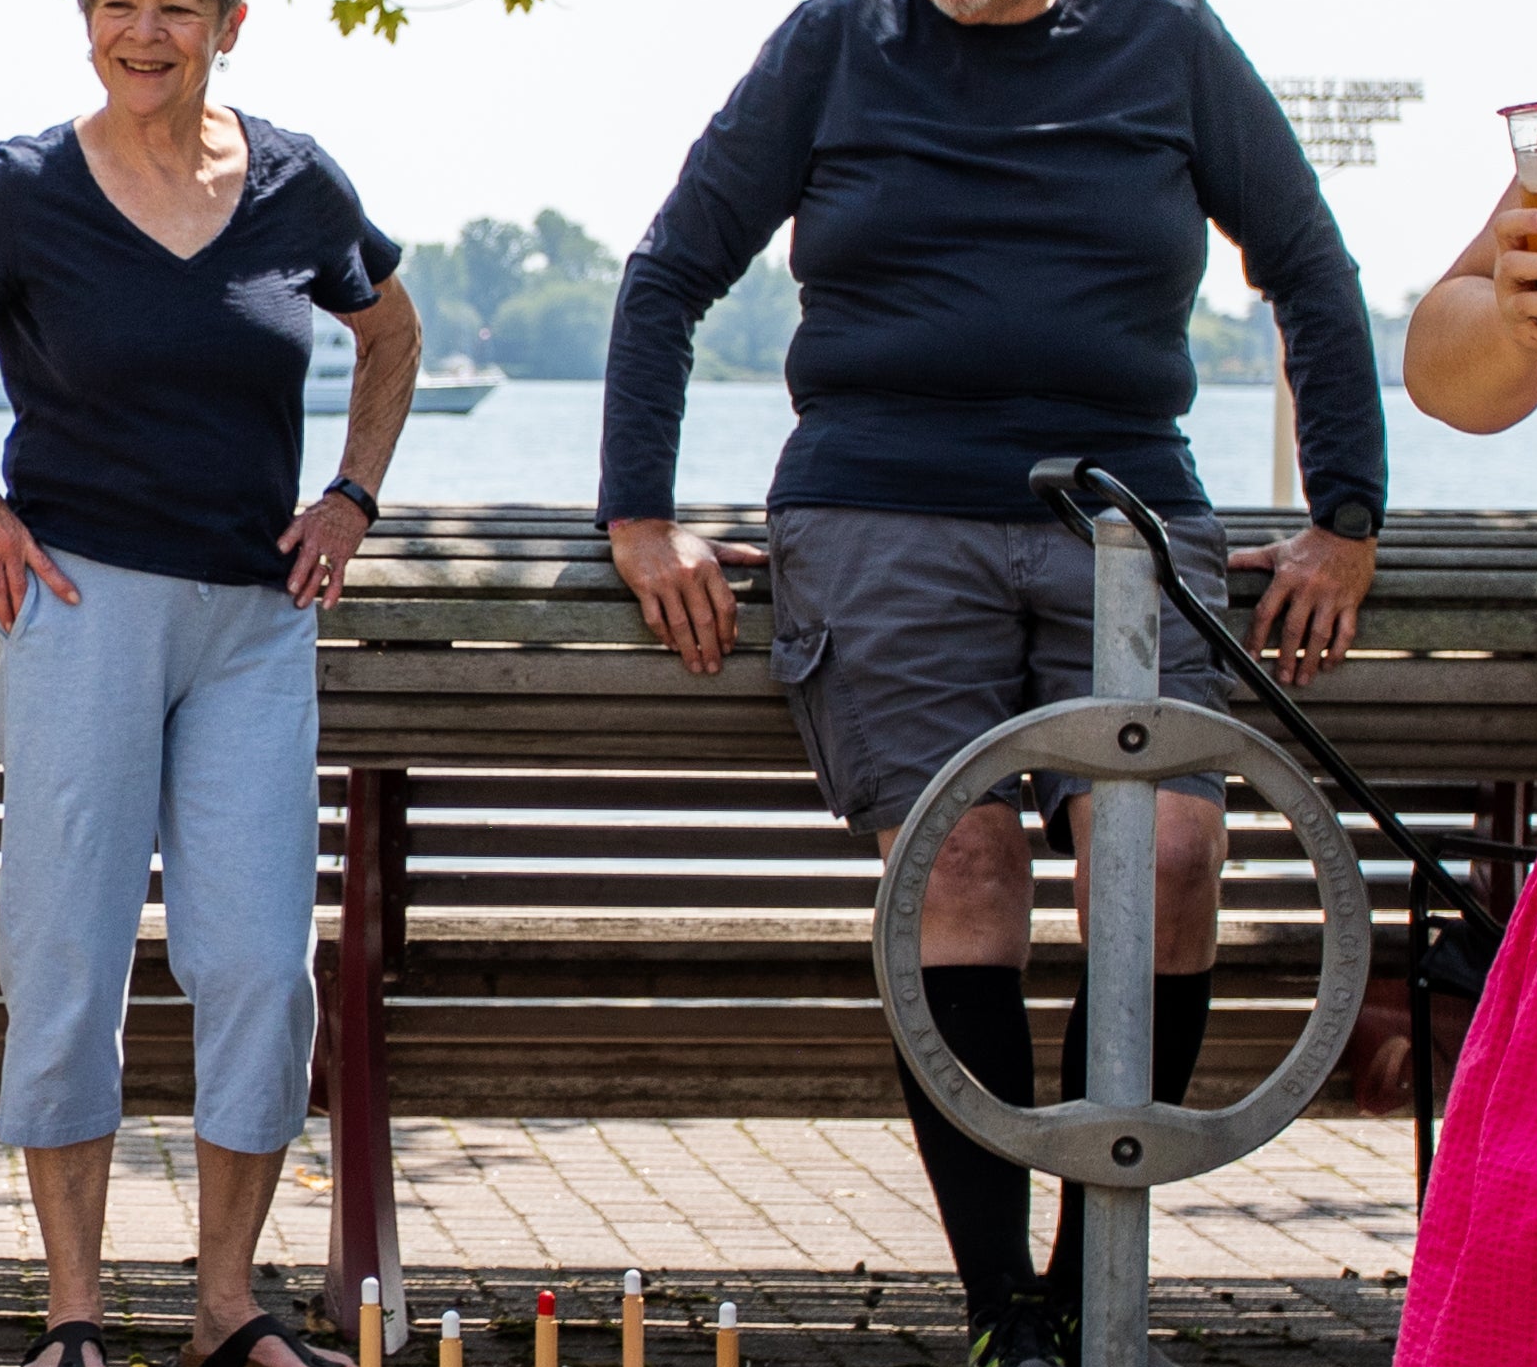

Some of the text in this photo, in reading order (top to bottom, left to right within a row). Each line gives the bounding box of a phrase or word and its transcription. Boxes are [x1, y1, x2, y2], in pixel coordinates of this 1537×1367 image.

[896, 784, 970, 1093] CITY OF TORONTO
